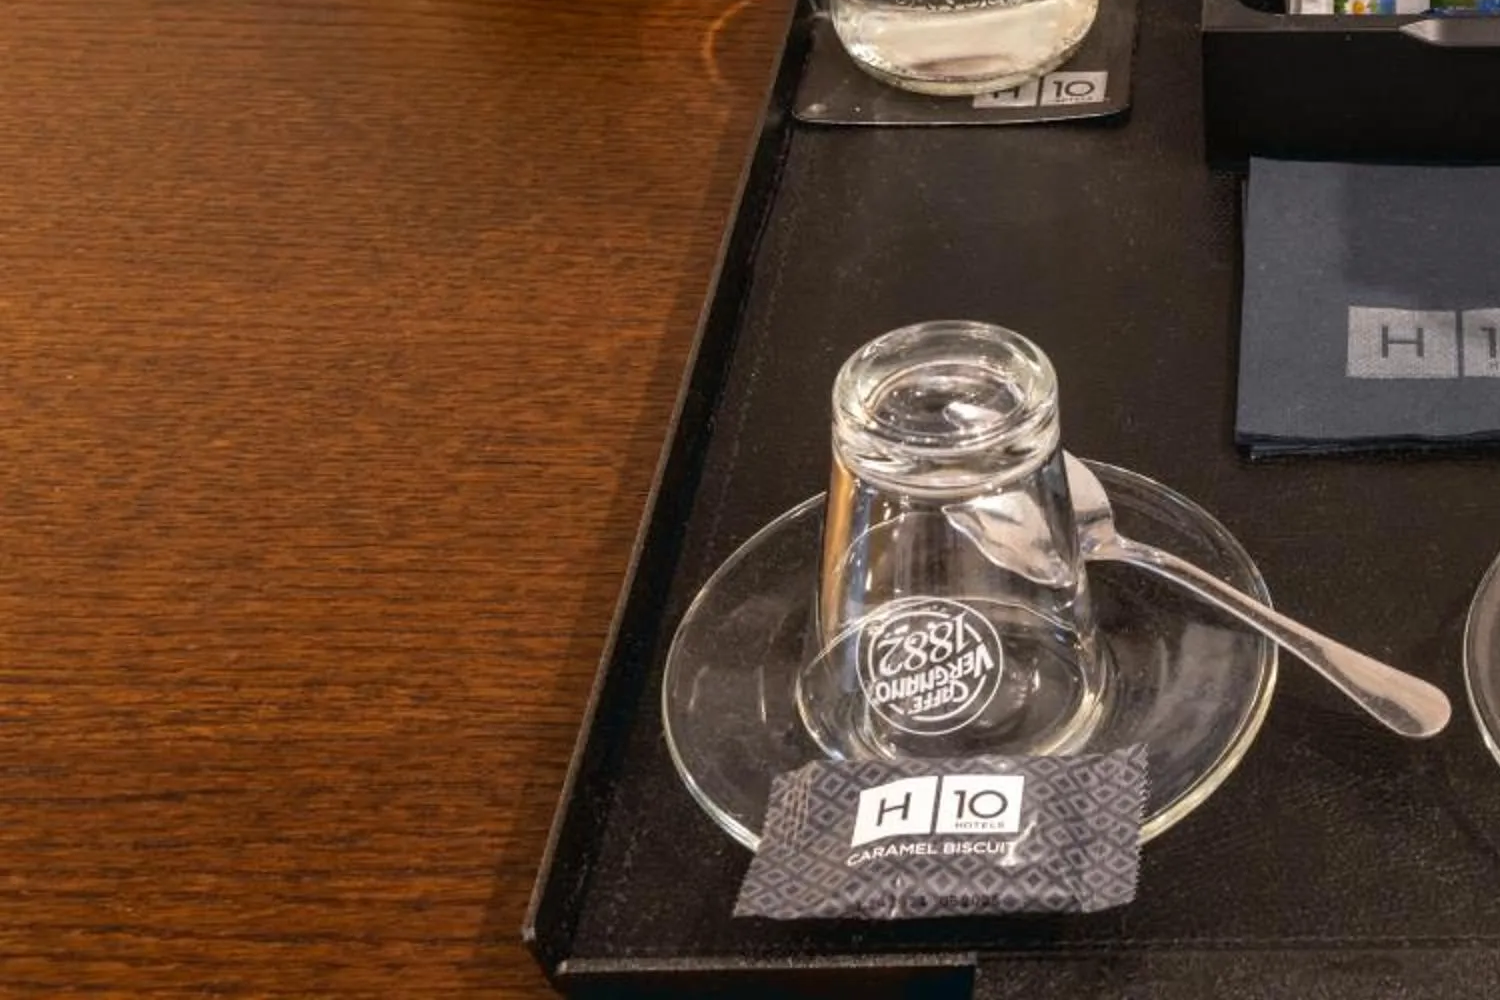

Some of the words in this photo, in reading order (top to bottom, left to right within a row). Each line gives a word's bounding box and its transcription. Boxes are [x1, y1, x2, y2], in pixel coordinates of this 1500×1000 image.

[877, 610, 970, 677] 1882
[845, 841, 937, 867] CARAMEL
[943, 839, 1019, 856] BISCUIT
